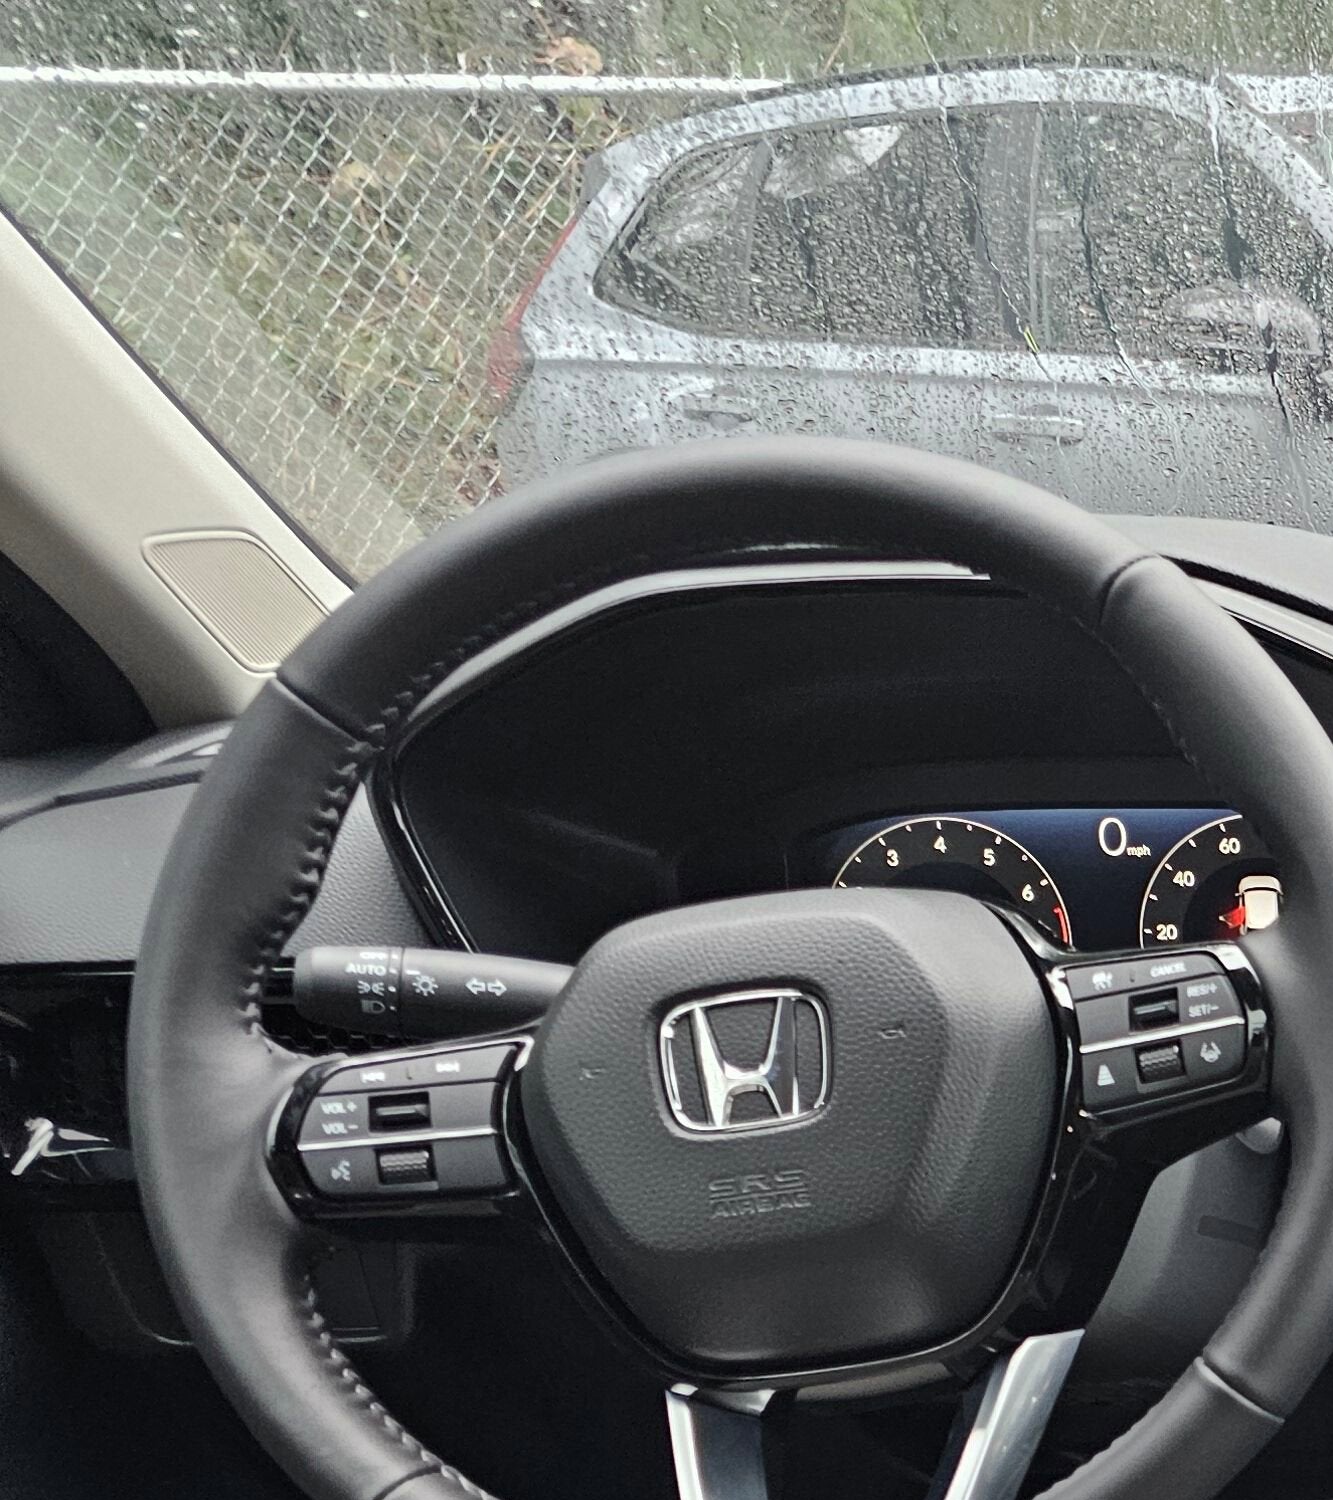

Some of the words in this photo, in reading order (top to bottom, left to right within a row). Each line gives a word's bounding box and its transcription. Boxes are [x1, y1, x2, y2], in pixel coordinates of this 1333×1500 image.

[933, 835, 947, 854] 4
[1098, 817, 1127, 857] 0
[1126, 844, 1151, 858] mph
[1218, 837, 1241, 854] 60
[886, 848, 899, 867] 3
[983, 847, 996, 867] 5
[1172, 870, 1195, 887] 40
[1021, 883, 1035, 902] 6
[1156, 923, 1178, 941] 20
[345, 962, 386, 976] AUTO
[708, 1170, 808, 1198] SRS
